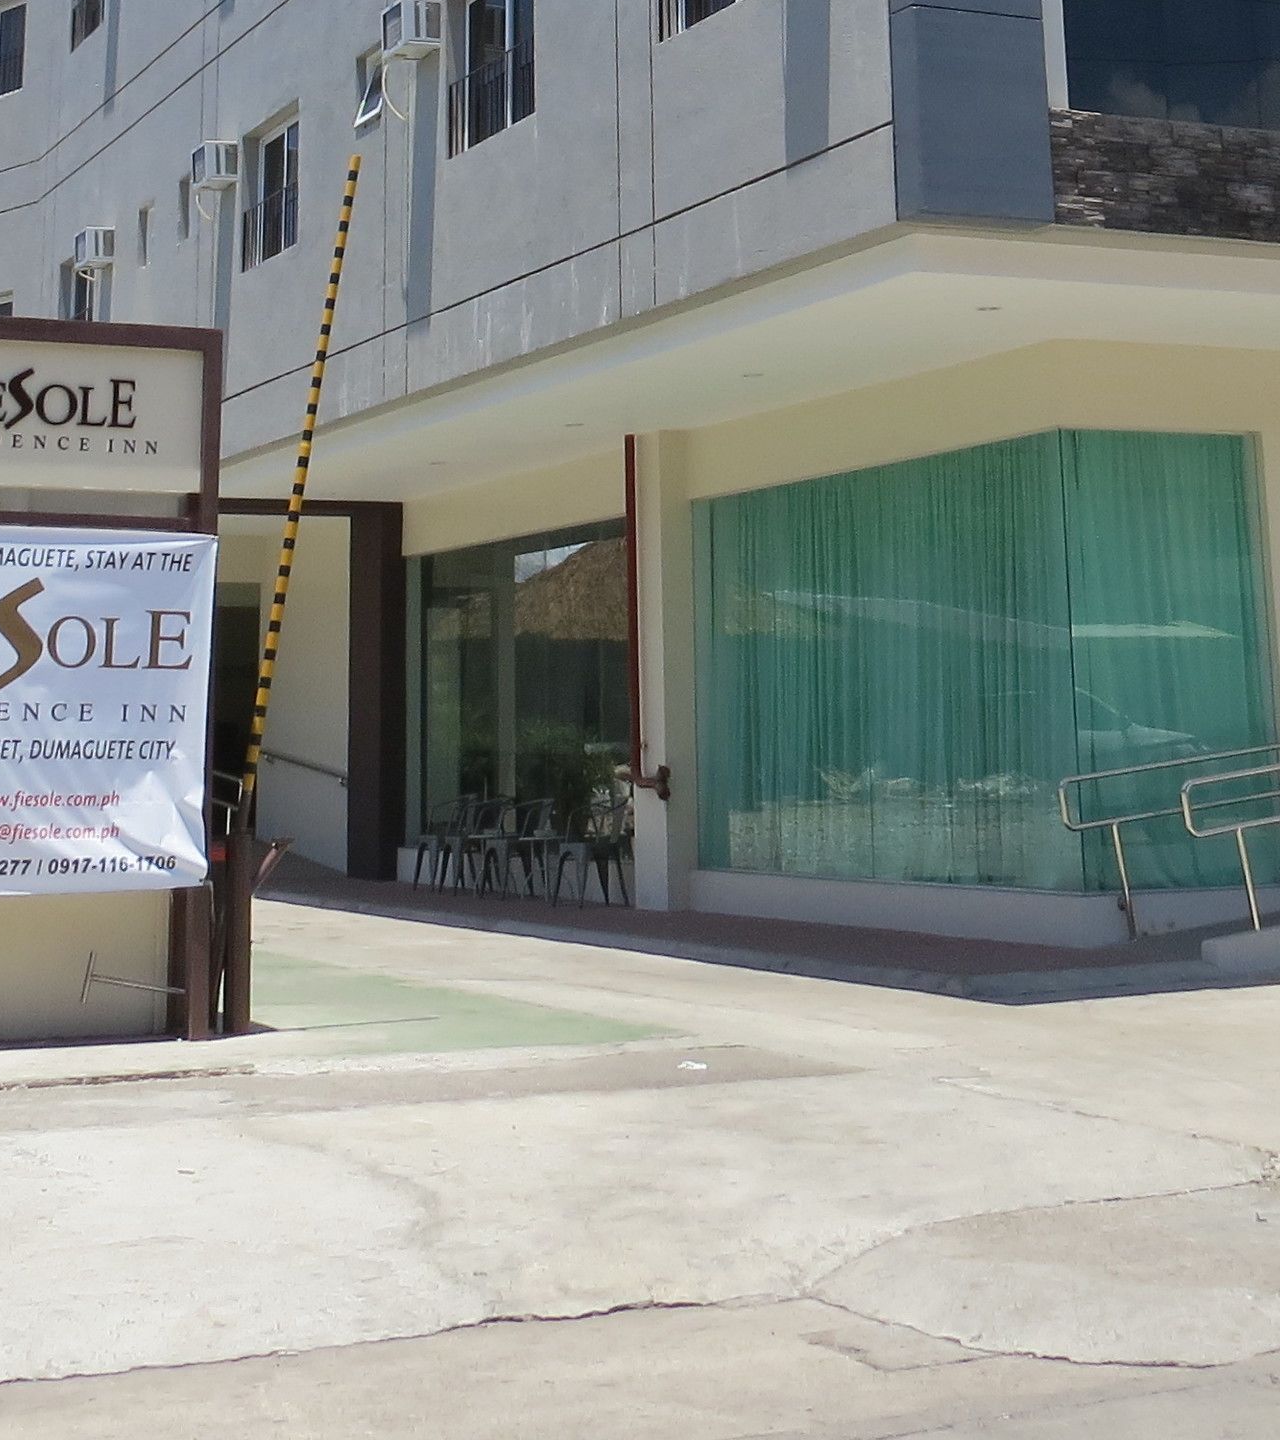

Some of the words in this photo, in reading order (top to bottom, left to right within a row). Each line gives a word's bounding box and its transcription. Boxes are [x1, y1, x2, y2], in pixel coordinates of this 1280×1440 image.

[108, 437, 158, 455] INN
[85, 550, 129, 569] STAY
[131, 551, 156, 571] AT
[161, 552, 193, 572] THE
[121, 703, 186, 723] INN
[29, 739, 135, 760] DUMAGUETE
[139, 740, 176, 760] CITY
